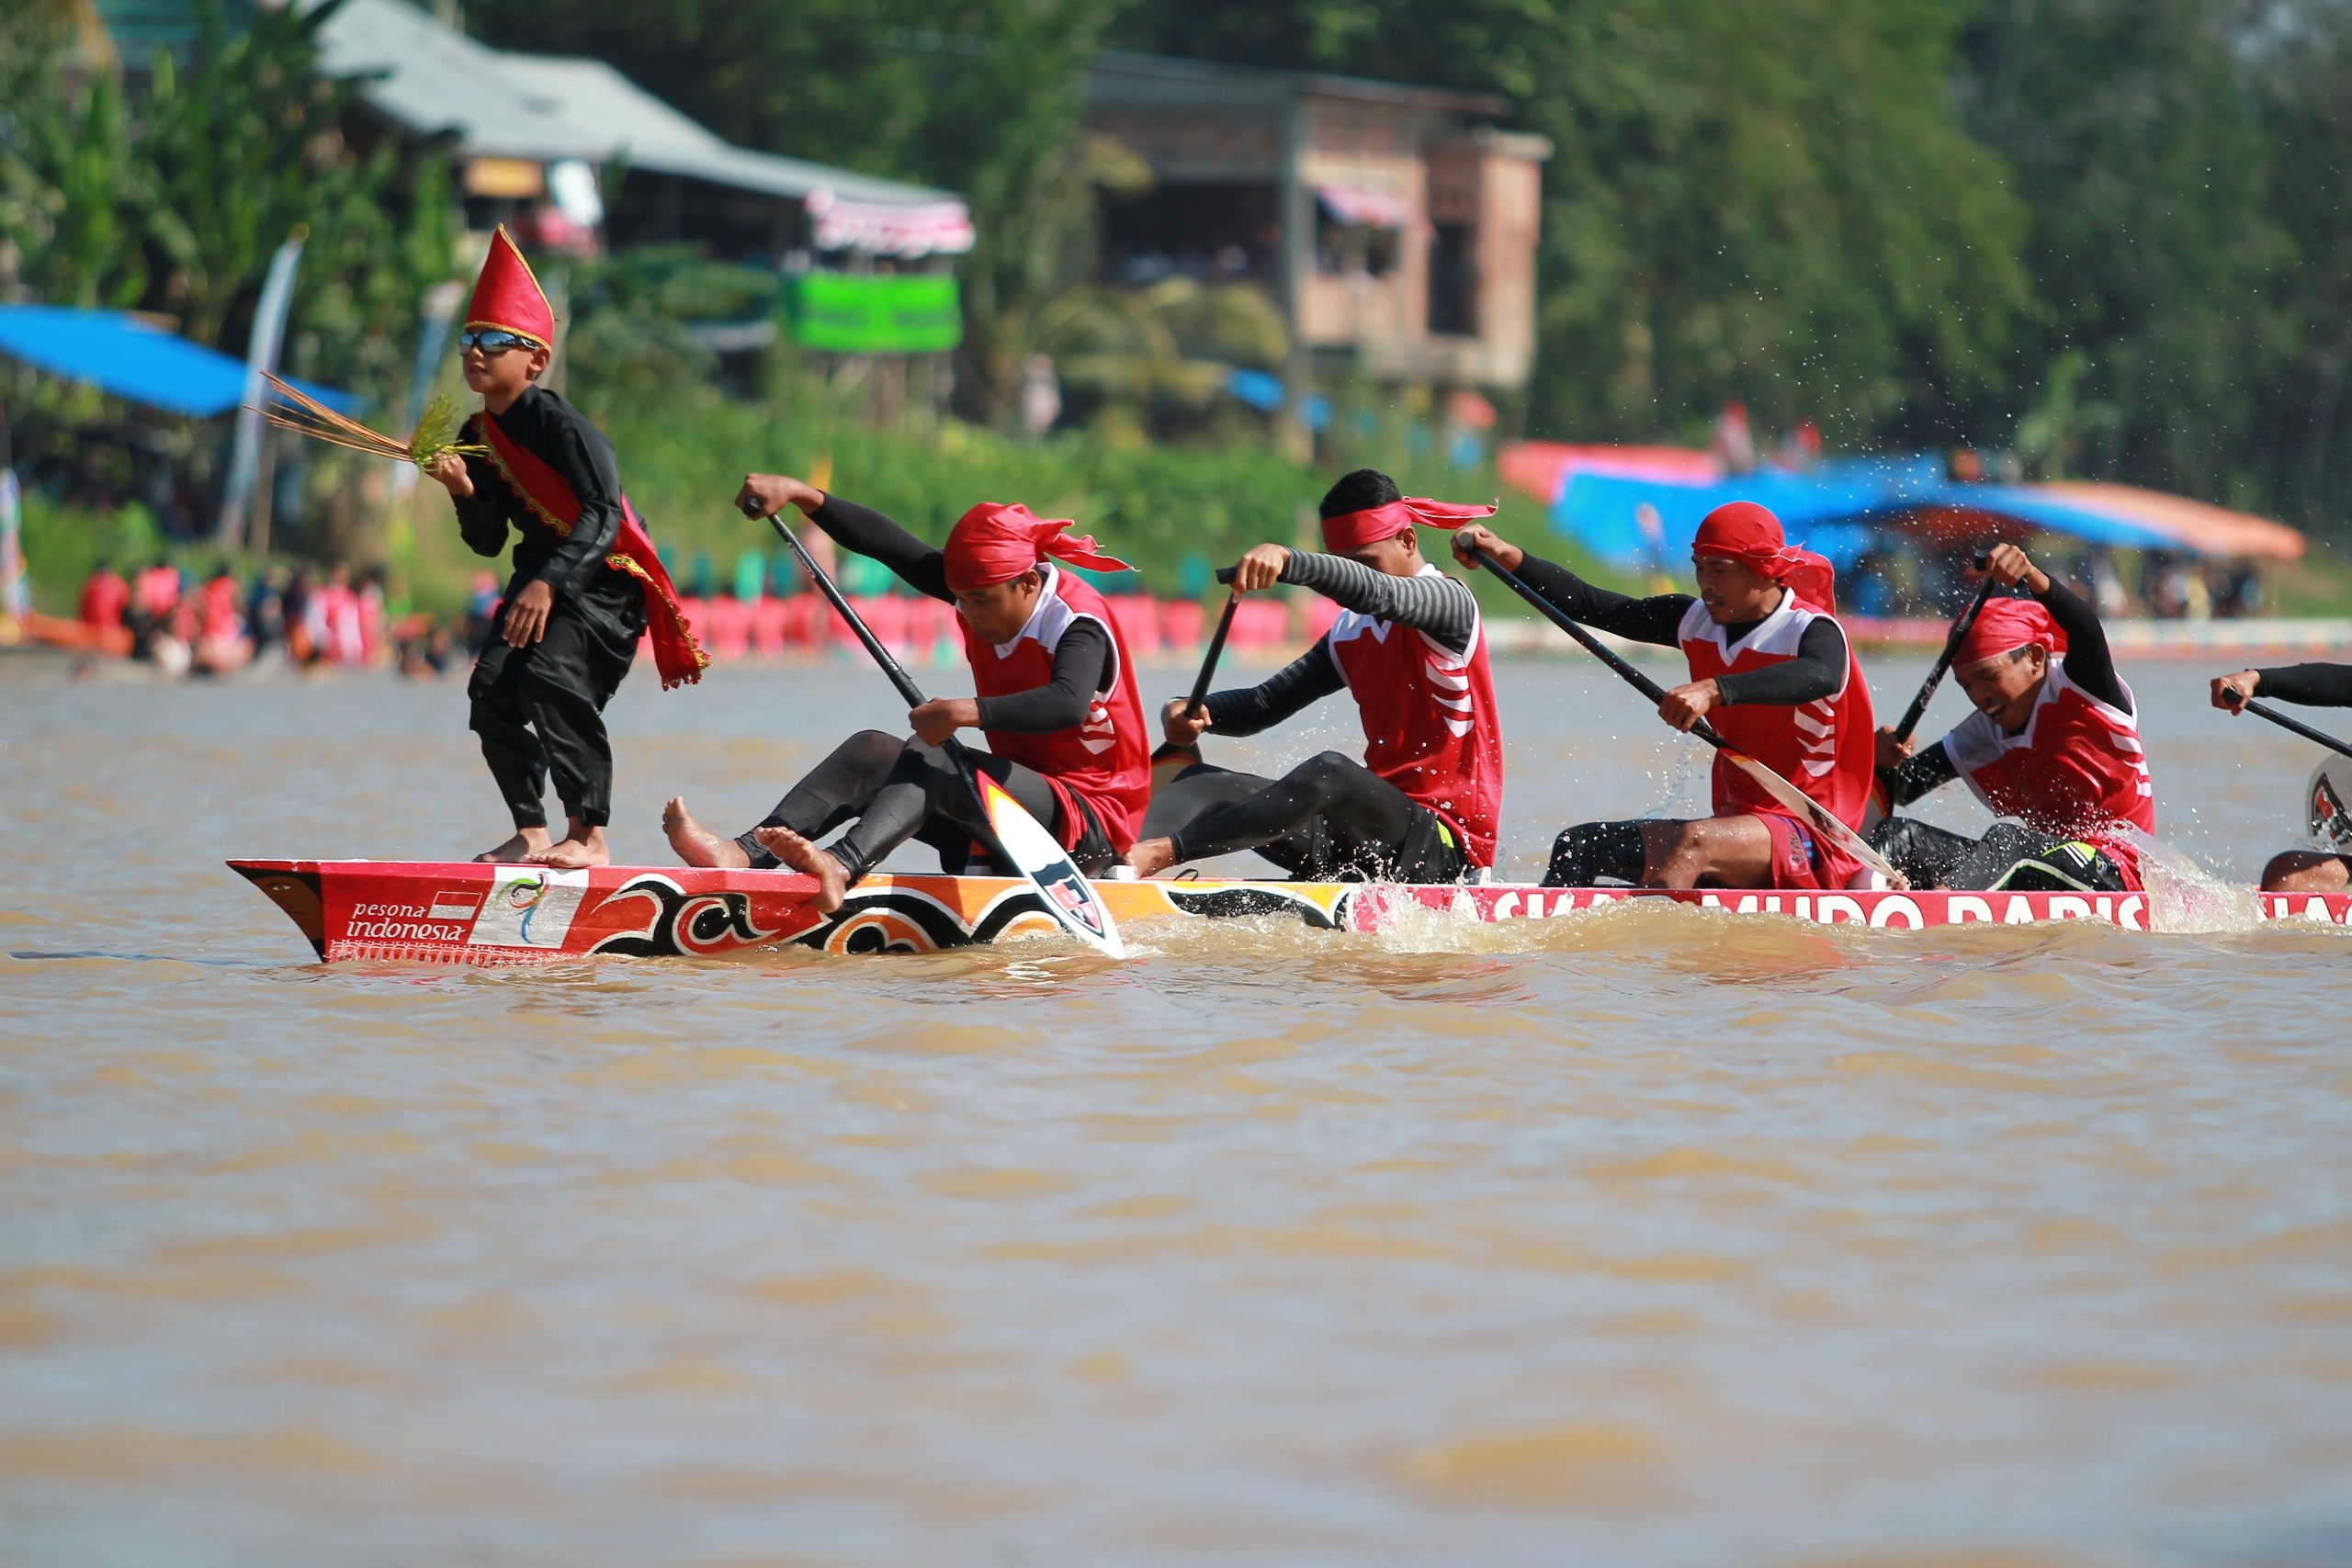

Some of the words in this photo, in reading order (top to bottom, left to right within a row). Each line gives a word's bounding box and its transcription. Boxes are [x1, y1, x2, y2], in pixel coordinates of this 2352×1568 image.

[353, 903, 426, 919] pesona
[1702, 894, 1924, 929] UDO
[346, 918, 466, 942] indonesia
